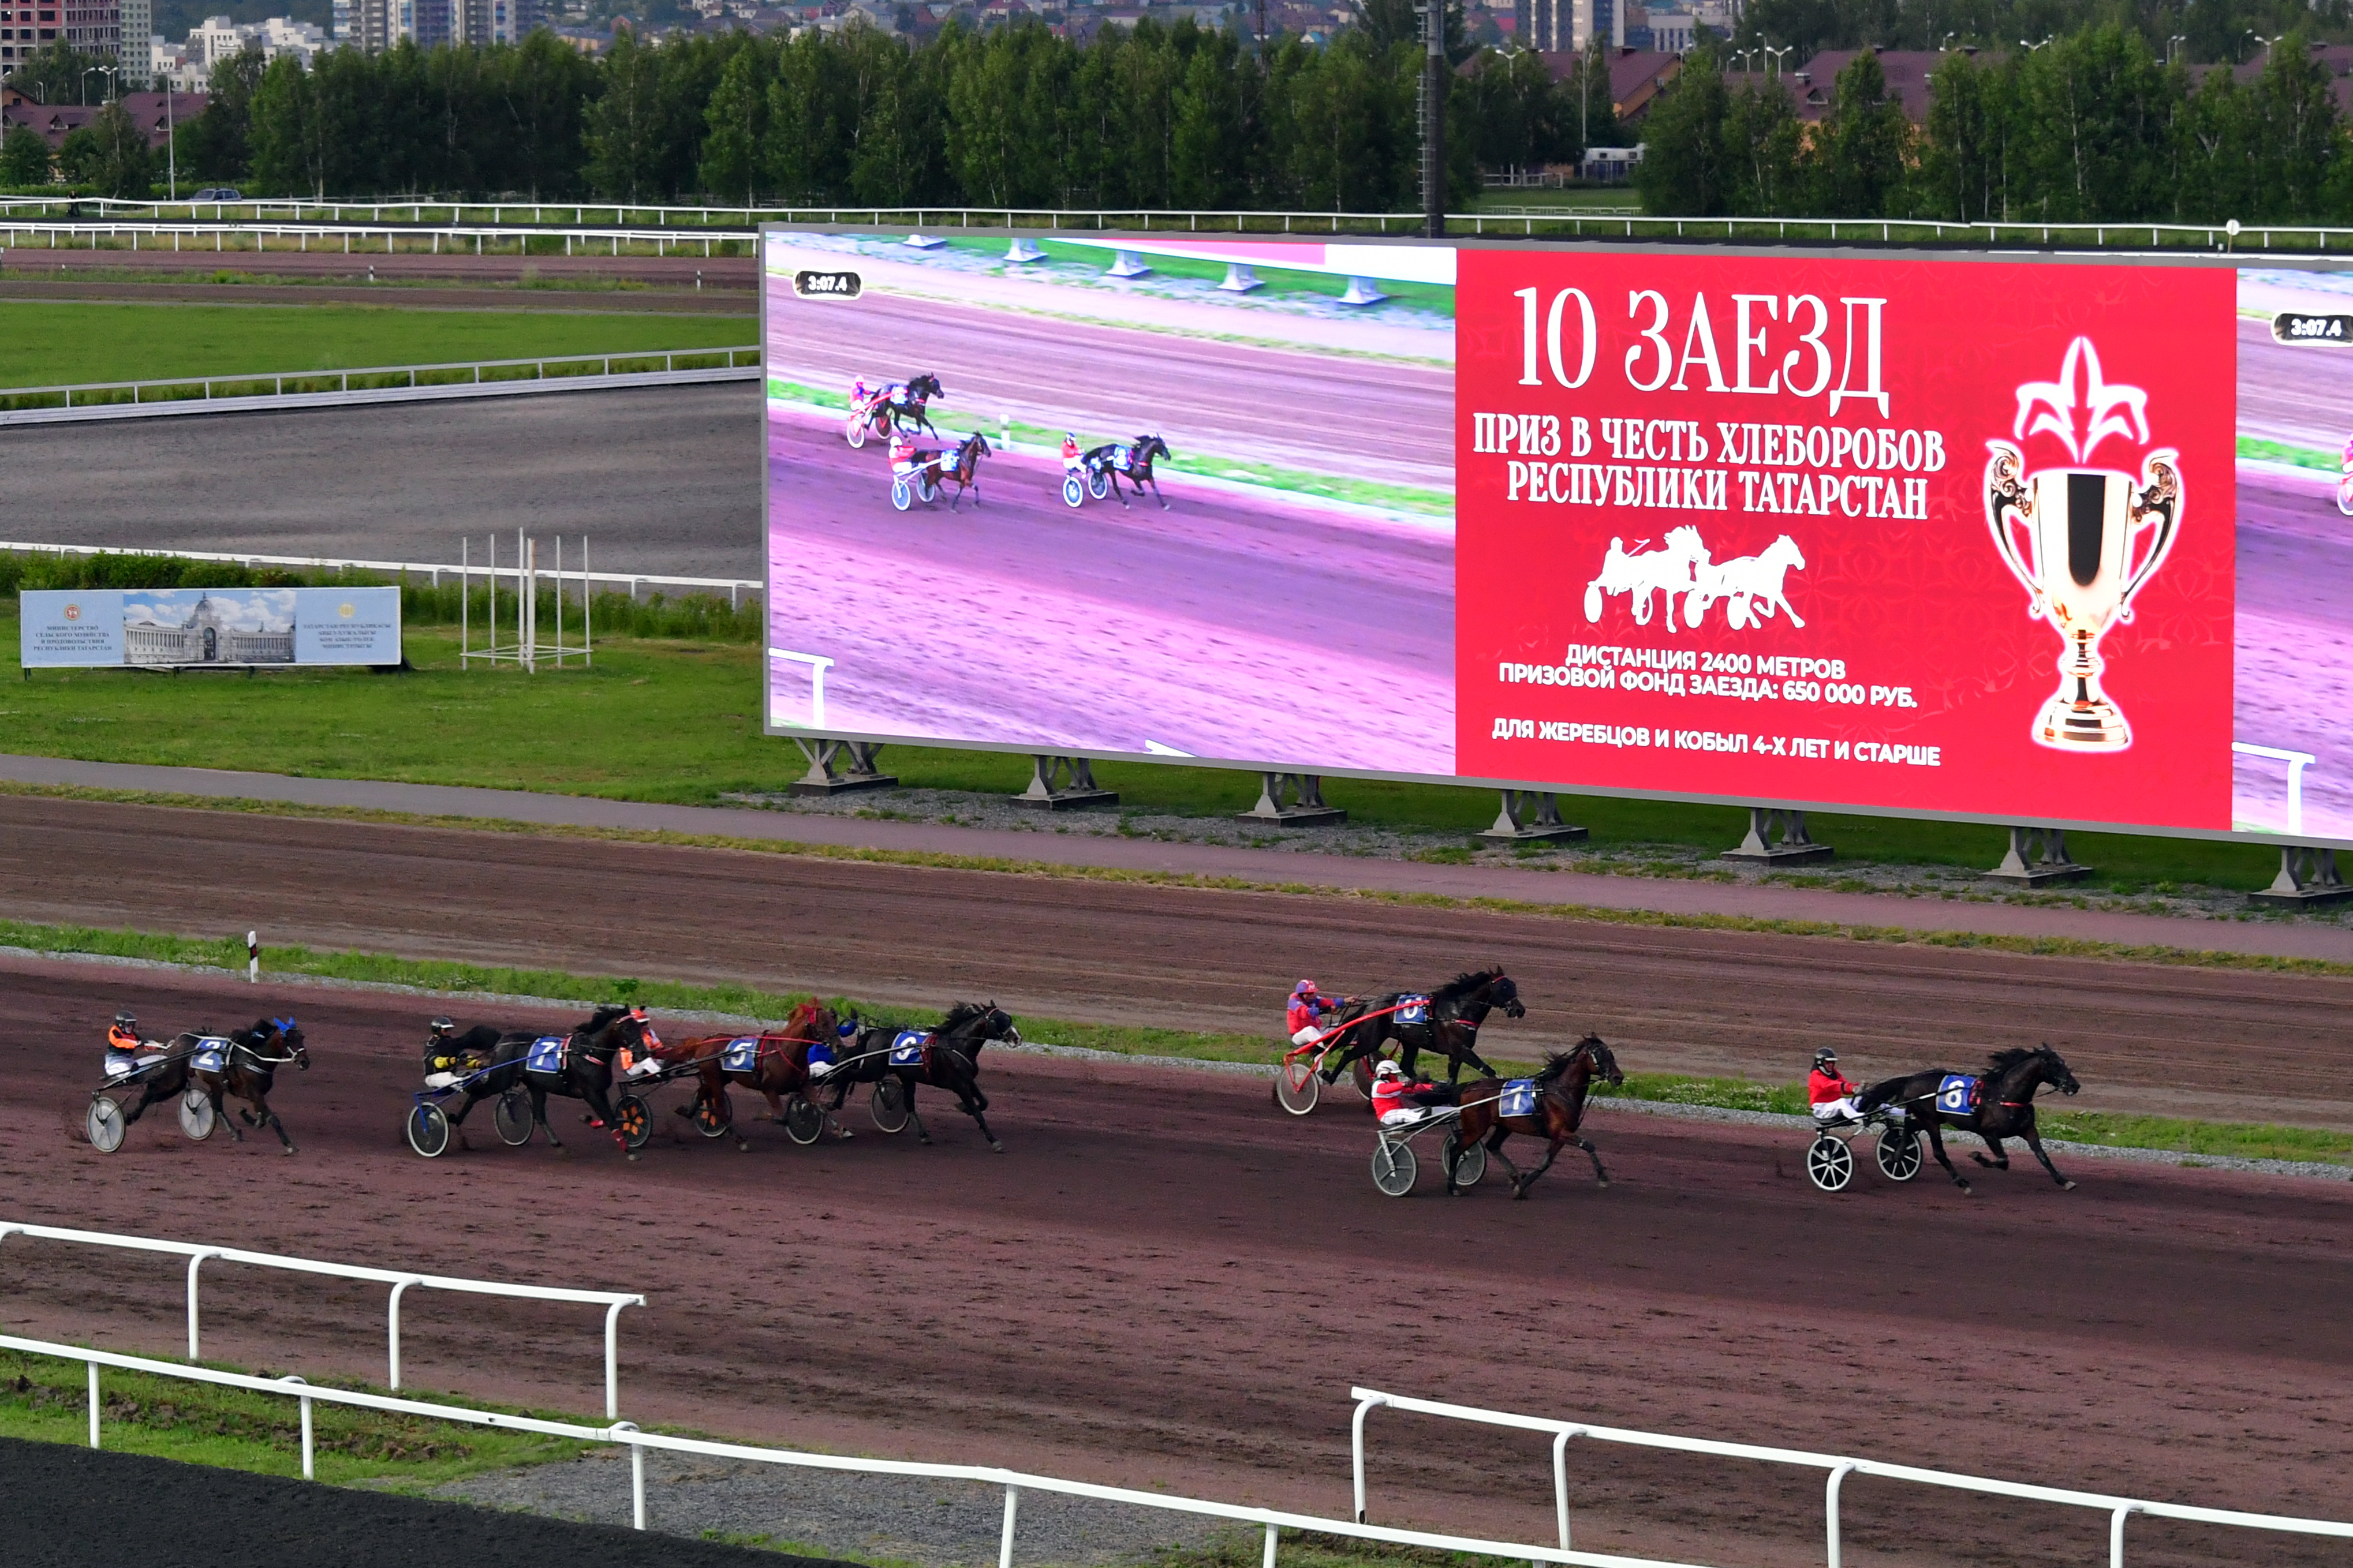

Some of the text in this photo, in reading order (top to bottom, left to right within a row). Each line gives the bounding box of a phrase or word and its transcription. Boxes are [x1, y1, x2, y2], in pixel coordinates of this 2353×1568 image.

[808, 275, 847, 291] 3:07.4
[2291, 318, 2342, 336] 3:07.4
[1514, 287, 1889, 420] 10 ЗАЕЗД
[1473, 412, 1945, 472] ПРИЗ В ЧЕСТЬ ХЛЕБОРОБОВ
[1507, 461, 1928, 520] РЕСПУБЛИКИ ТАТАРСТАН
[1566, 644, 1846, 680] ДИСТАНЦИЯ 2400 МЕТРОВ
[1499, 661, 1918, 708] ПРИЗОВОЙ ФОНД ЗАЕЗДА: 650 000 РУБ.
[1492, 717, 1941, 766] ДЛЯ ЖЕРЕБЦОВ И КОБЫЛ 4-Х ЛЕТ И СТАРШЕ
[198, 1041, 221, 1066] 2
[535, 1041, 558, 1066] 7
[730, 1042, 753, 1066] 5
[896, 1036, 917, 1061] 9
[1510, 1084, 1525, 1110] 1
